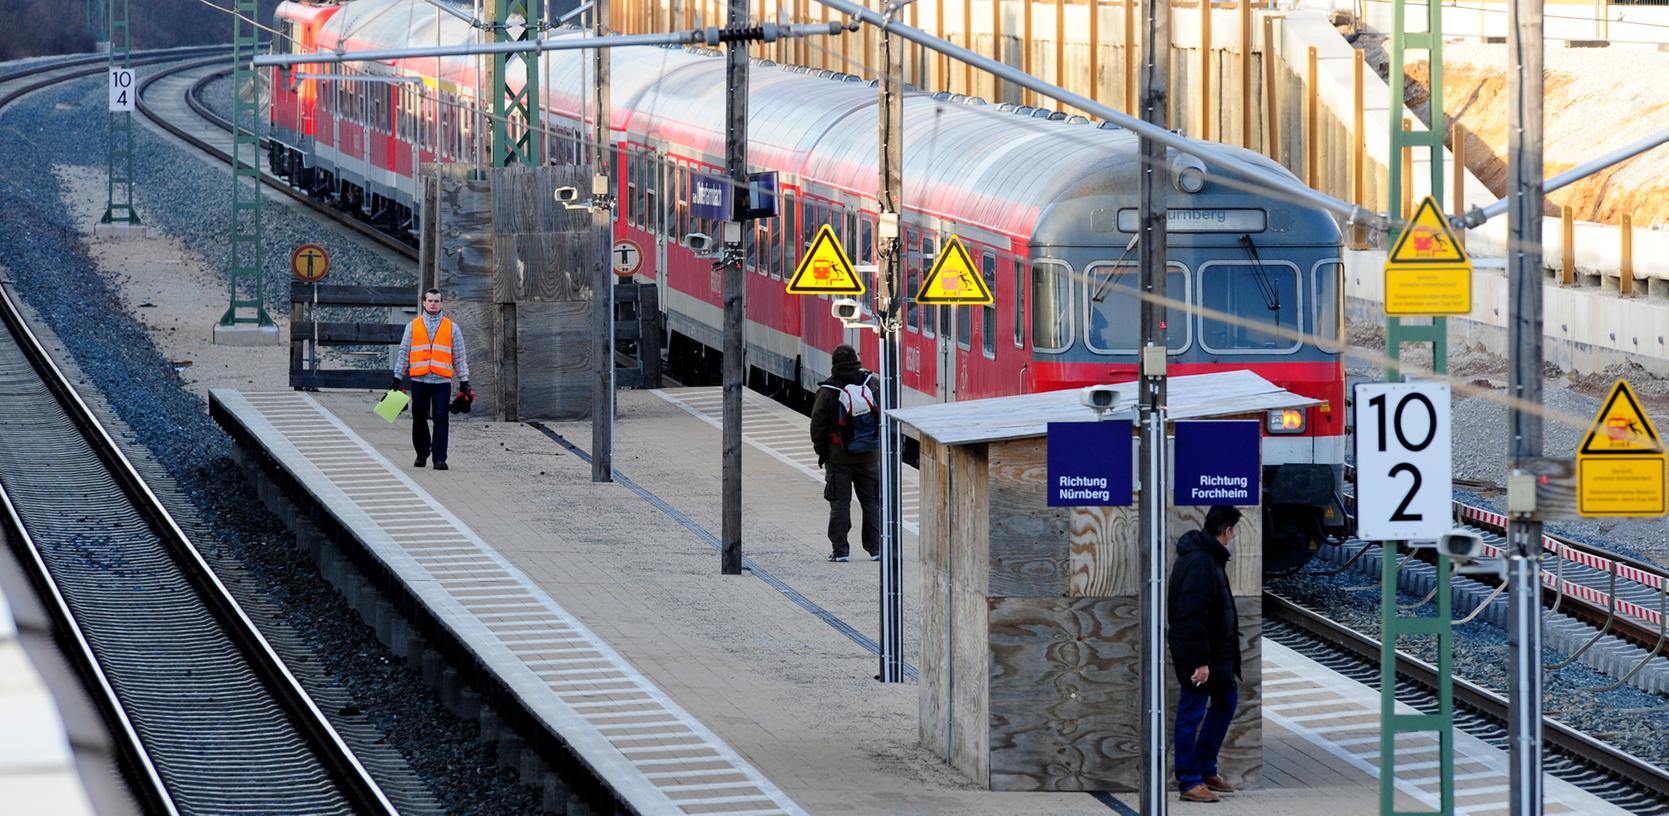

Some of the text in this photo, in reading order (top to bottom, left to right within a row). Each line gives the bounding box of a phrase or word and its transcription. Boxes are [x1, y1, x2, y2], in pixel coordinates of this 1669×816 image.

[112, 71, 131, 88] 10
[117, 90, 127, 106] 4
[1369, 392, 1437, 452] 10
[1059, 476, 1107, 489] Richtung
[1200, 475, 1248, 488] Richtung
[1059, 488, 1110, 501] Nürnberg
[1191, 488, 1248, 499] Forchheim
[1388, 462, 1422, 521] 2
